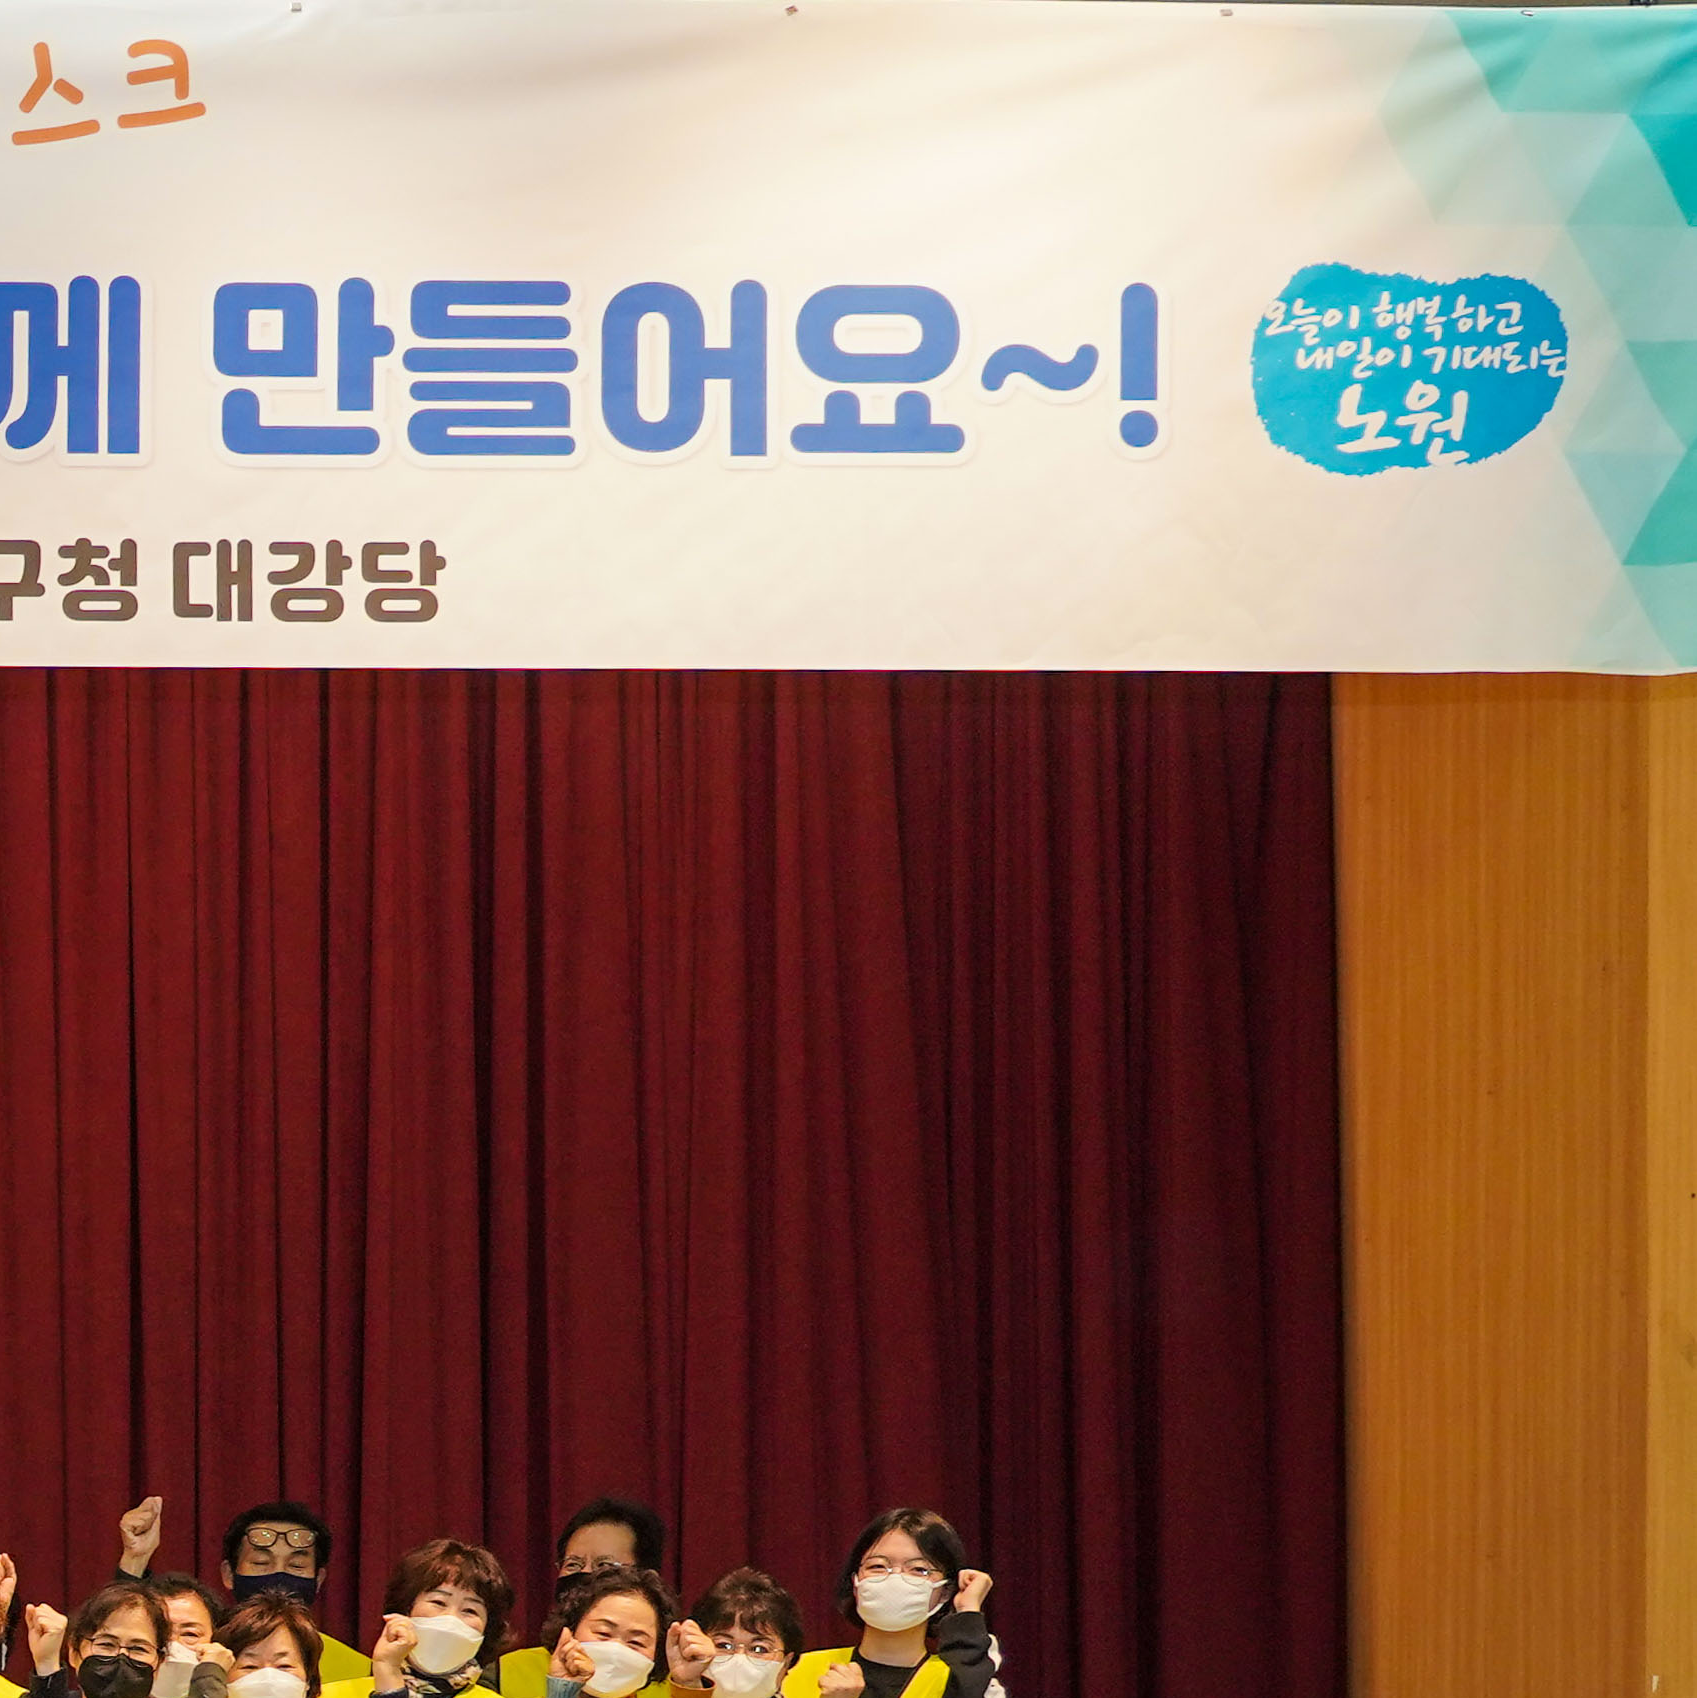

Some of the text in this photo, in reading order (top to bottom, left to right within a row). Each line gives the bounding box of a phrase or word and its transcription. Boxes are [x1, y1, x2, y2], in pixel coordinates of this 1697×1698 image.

[1264, 291, 1524, 346] 오늘이 행복하고
[1295, 337, 1568, 379] 내일이 기대되는
[1336, 380, 1470, 466] 노원
[172, 539, 447, 622] 대강당
